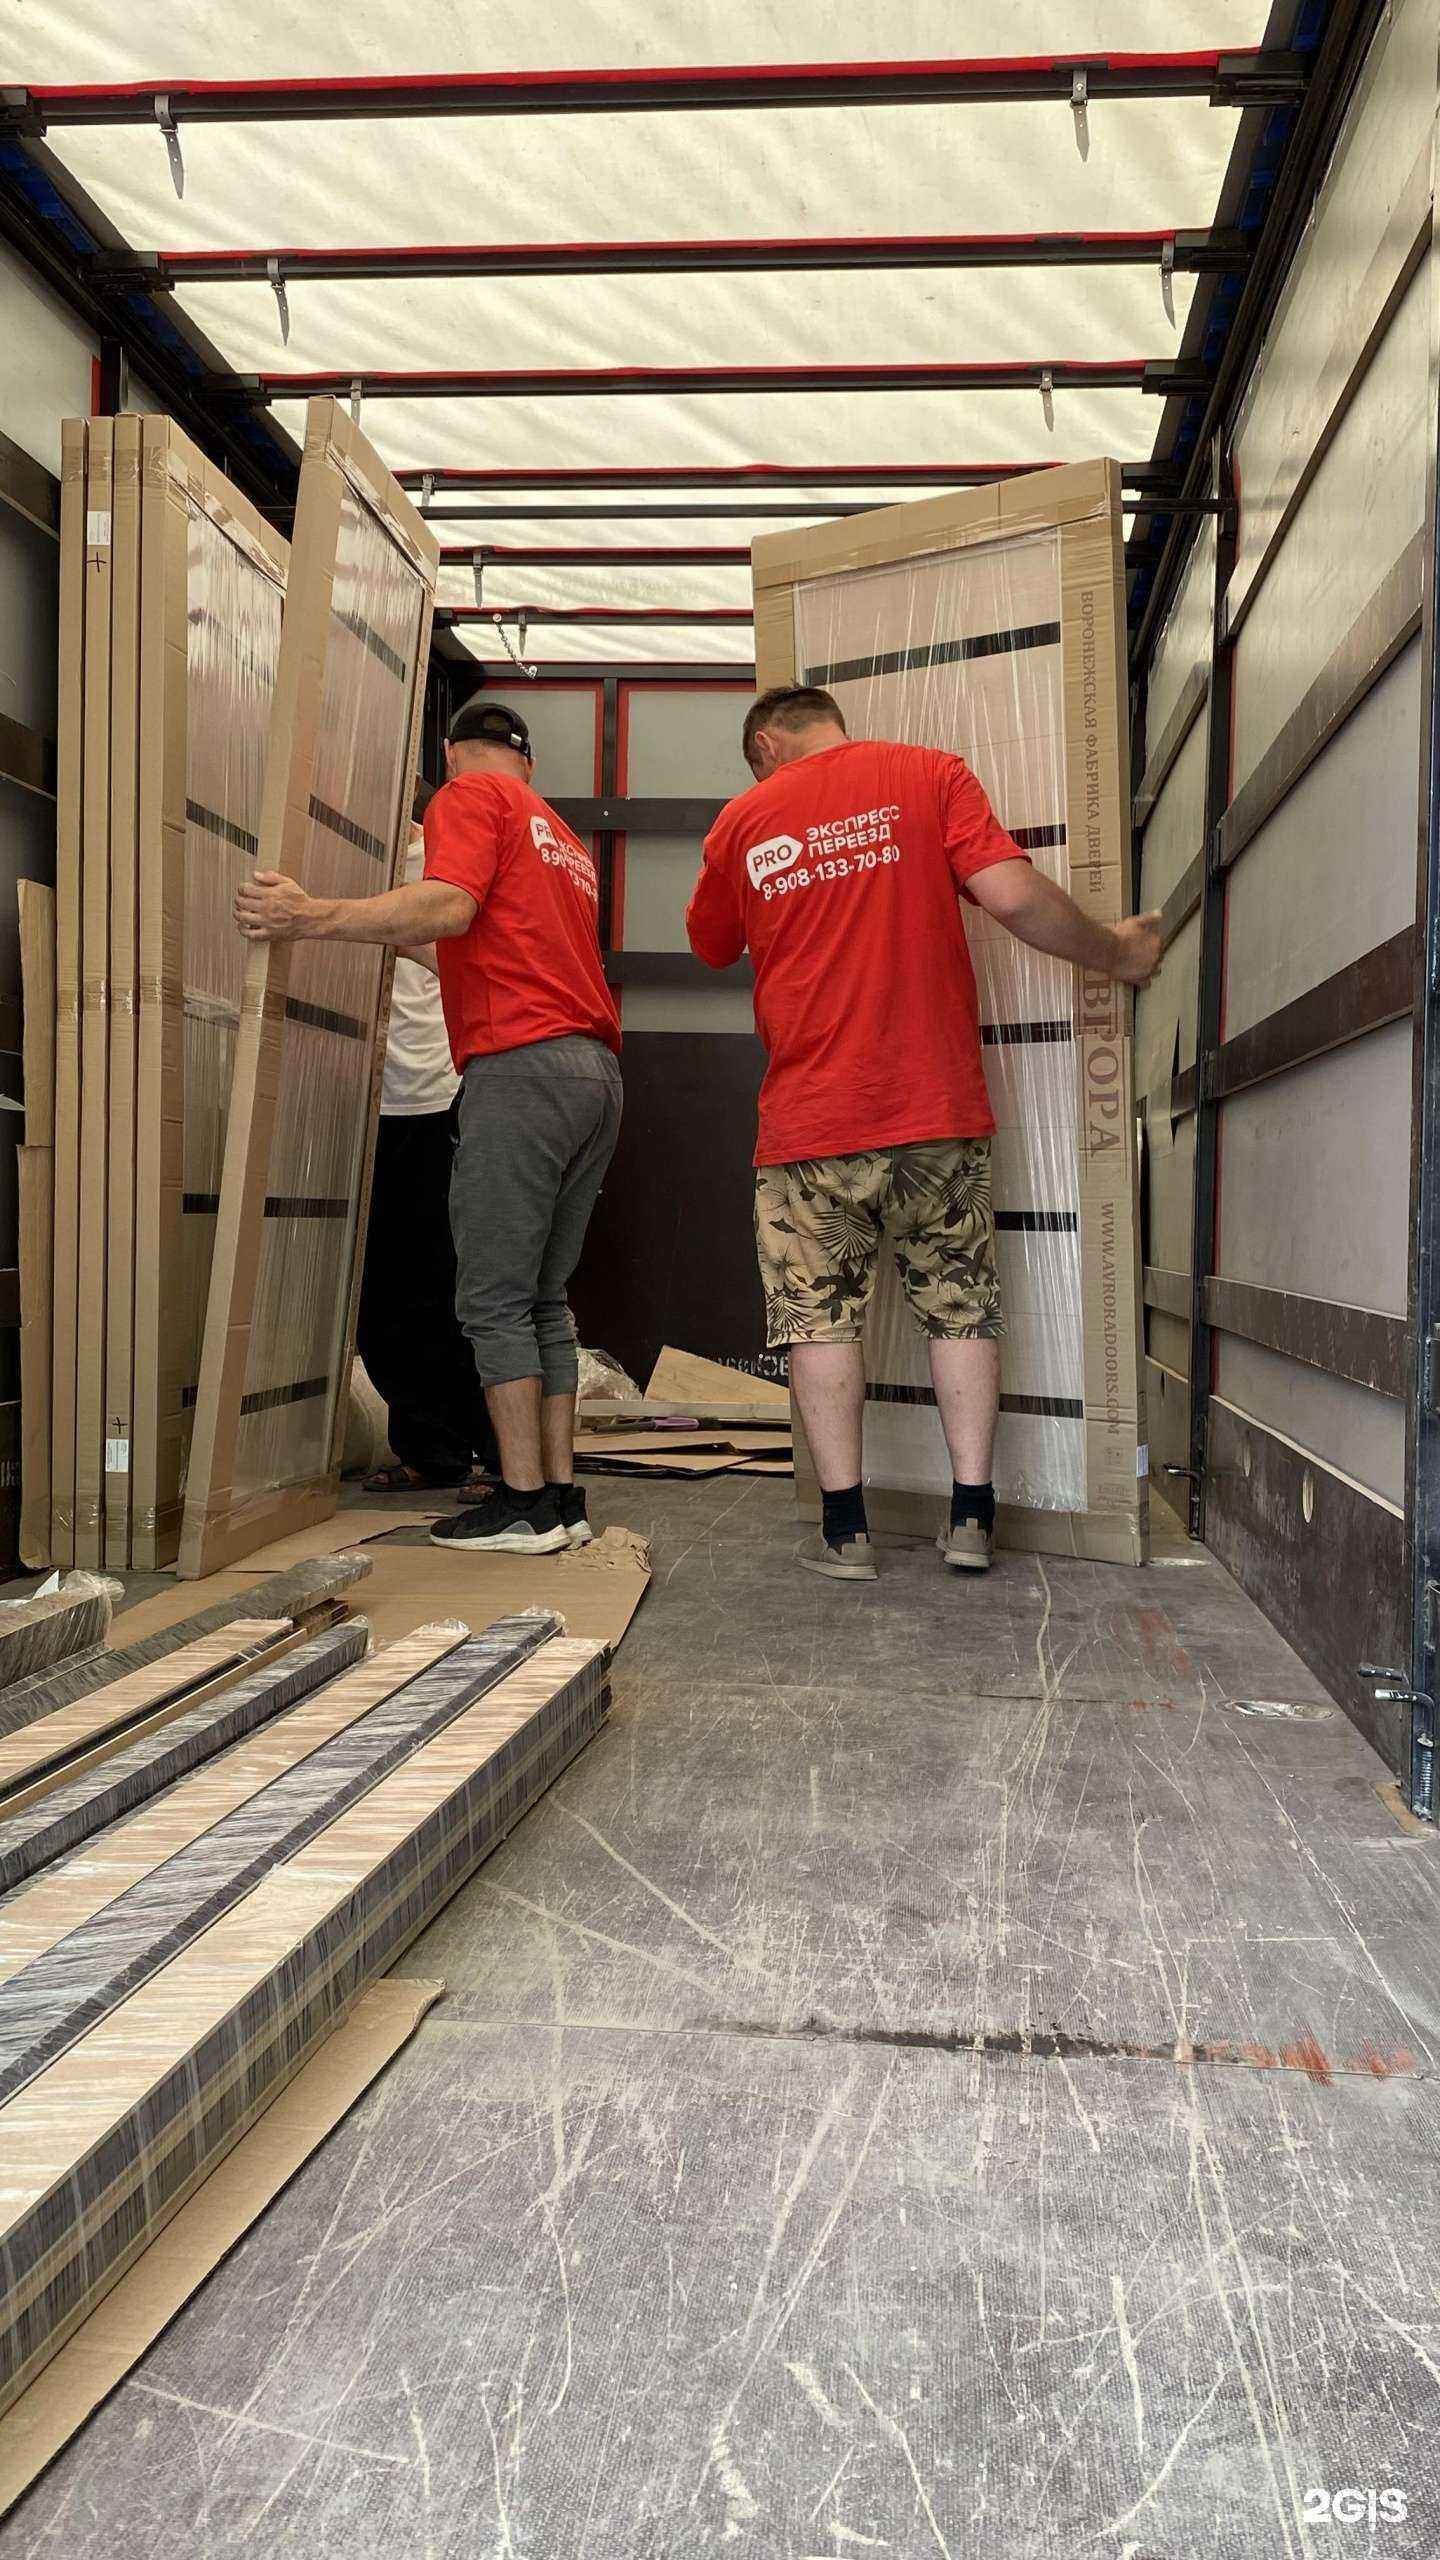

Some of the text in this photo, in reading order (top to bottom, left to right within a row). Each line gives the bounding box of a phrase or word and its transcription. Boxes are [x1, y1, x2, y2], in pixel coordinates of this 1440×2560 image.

[1080, 590, 1105, 894] ВОРОНЕЖСКАЯ ФАБРИКА ДВЕРЕЙ
[806, 804, 900, 842] ЭКСПРЕСС
[808, 823, 891, 858] ПЕРЕЕЗД
[752, 844, 792, 873] PRO
[761, 844, 900, 901] 8-908-133-70-80
[1083, 974, 1121, 1158] ВРОРА
[1100, 1200, 1120, 1436] WWW.AVRORADOORS.COM
